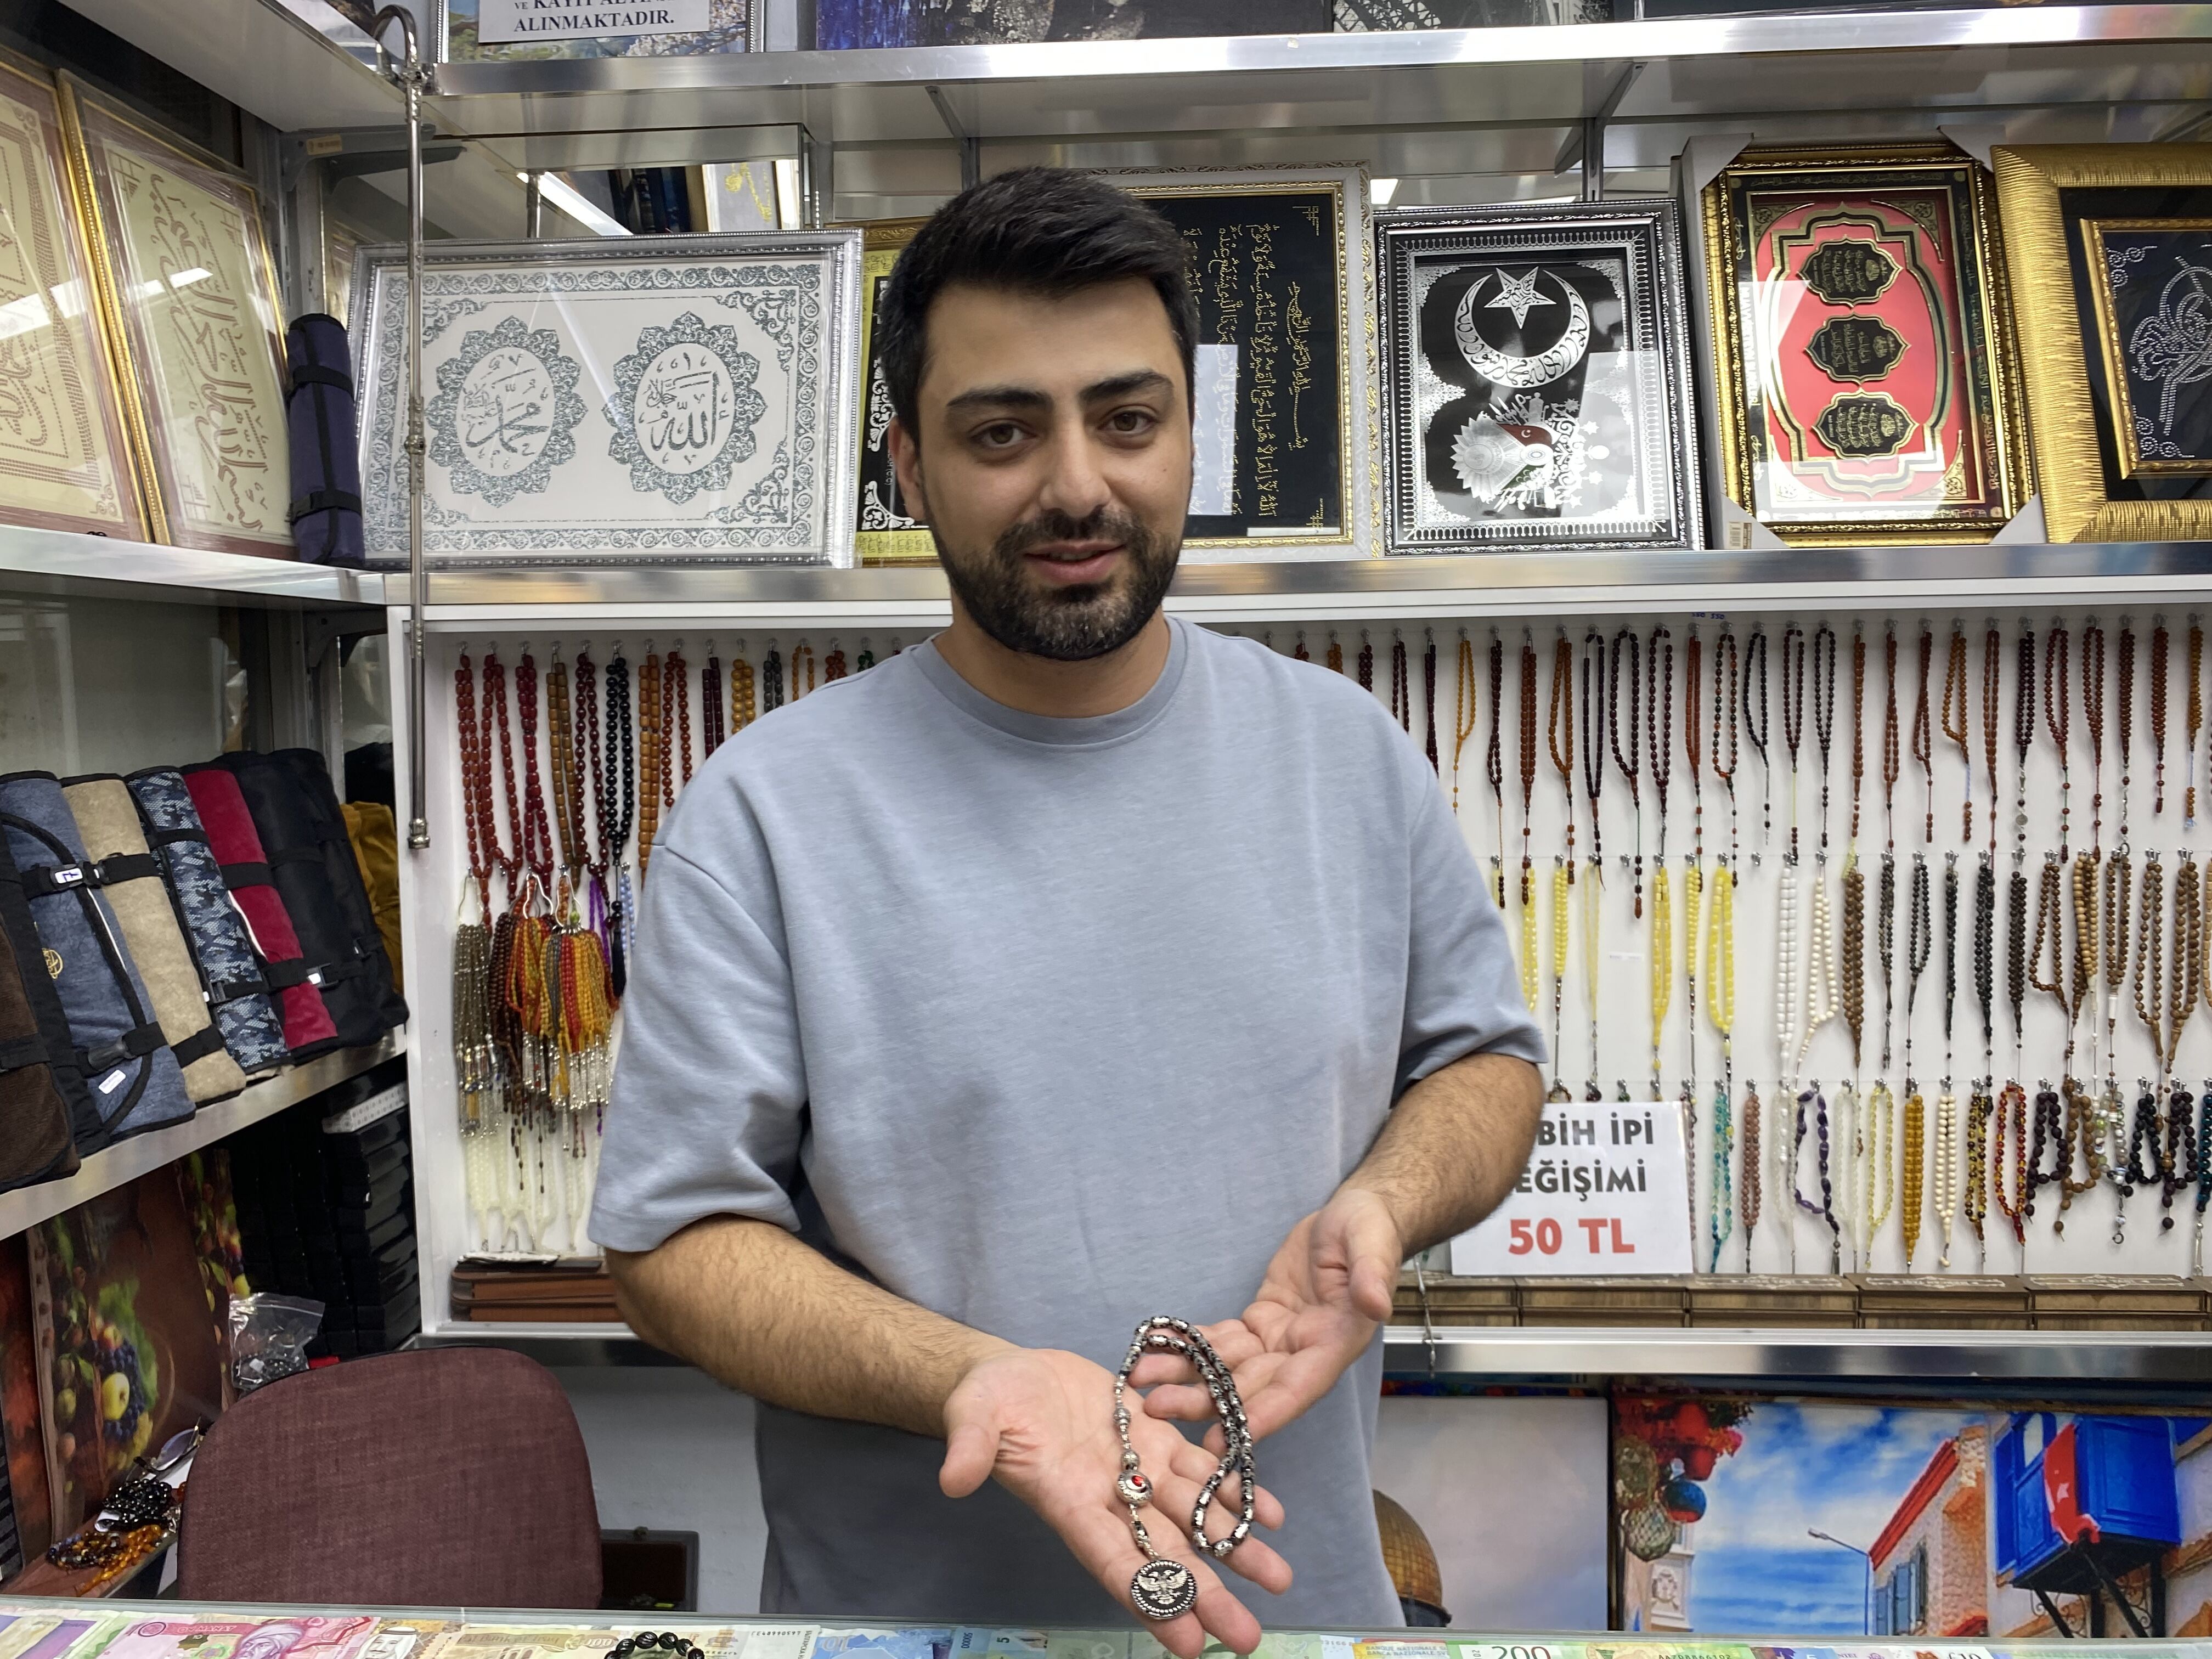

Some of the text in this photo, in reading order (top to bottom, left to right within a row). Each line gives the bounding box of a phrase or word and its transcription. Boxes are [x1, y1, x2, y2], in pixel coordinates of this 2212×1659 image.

[514, 10, 674, 32] ALINMAKTADIR.
[1538, 1111, 1654, 1145] BİH İPİ
[1516, 1158, 1646, 1202] EĞİŞİMİ
[1508, 1217, 1635, 1255] 50 TL
[961, 1632, 973, 1649] 50000
[1492, 1646, 1551, 1659] 200
